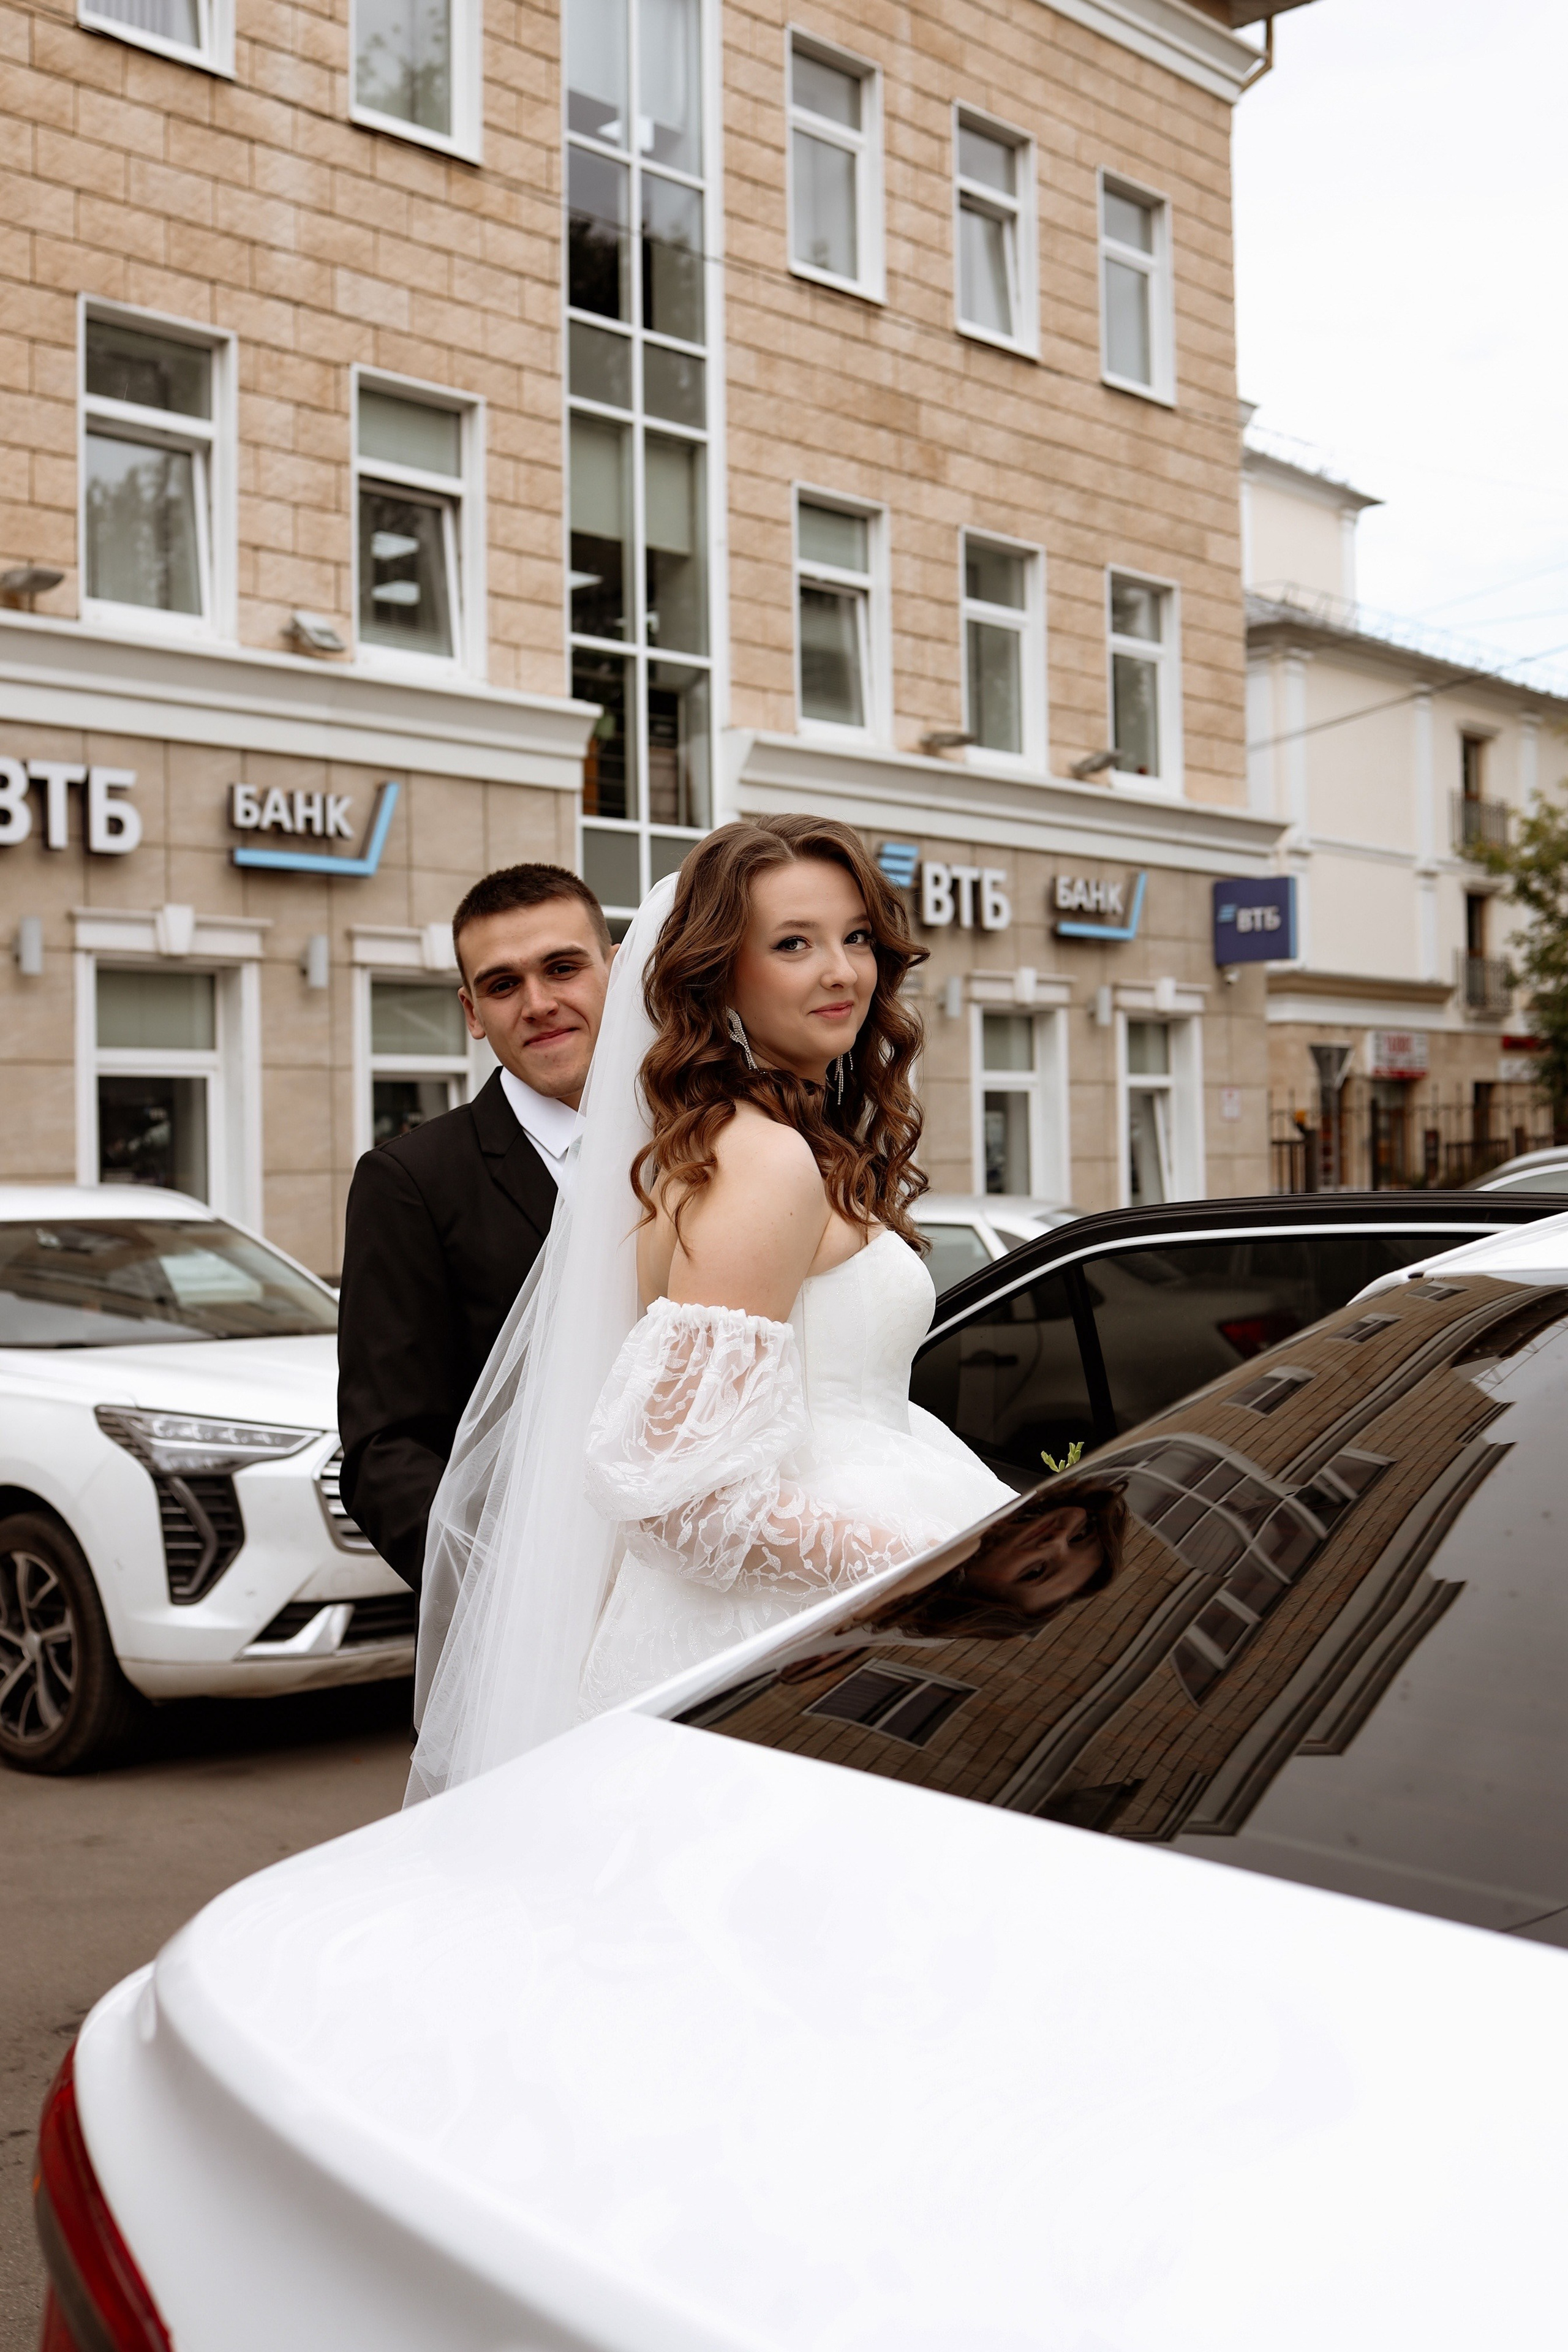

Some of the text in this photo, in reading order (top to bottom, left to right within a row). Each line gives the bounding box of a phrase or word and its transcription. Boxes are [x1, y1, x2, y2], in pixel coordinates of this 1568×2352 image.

[234, 782, 354, 839] БАНК
[922, 861, 1124, 931] ВТБ БАНК
[1237, 905, 1281, 933] ВТБ
